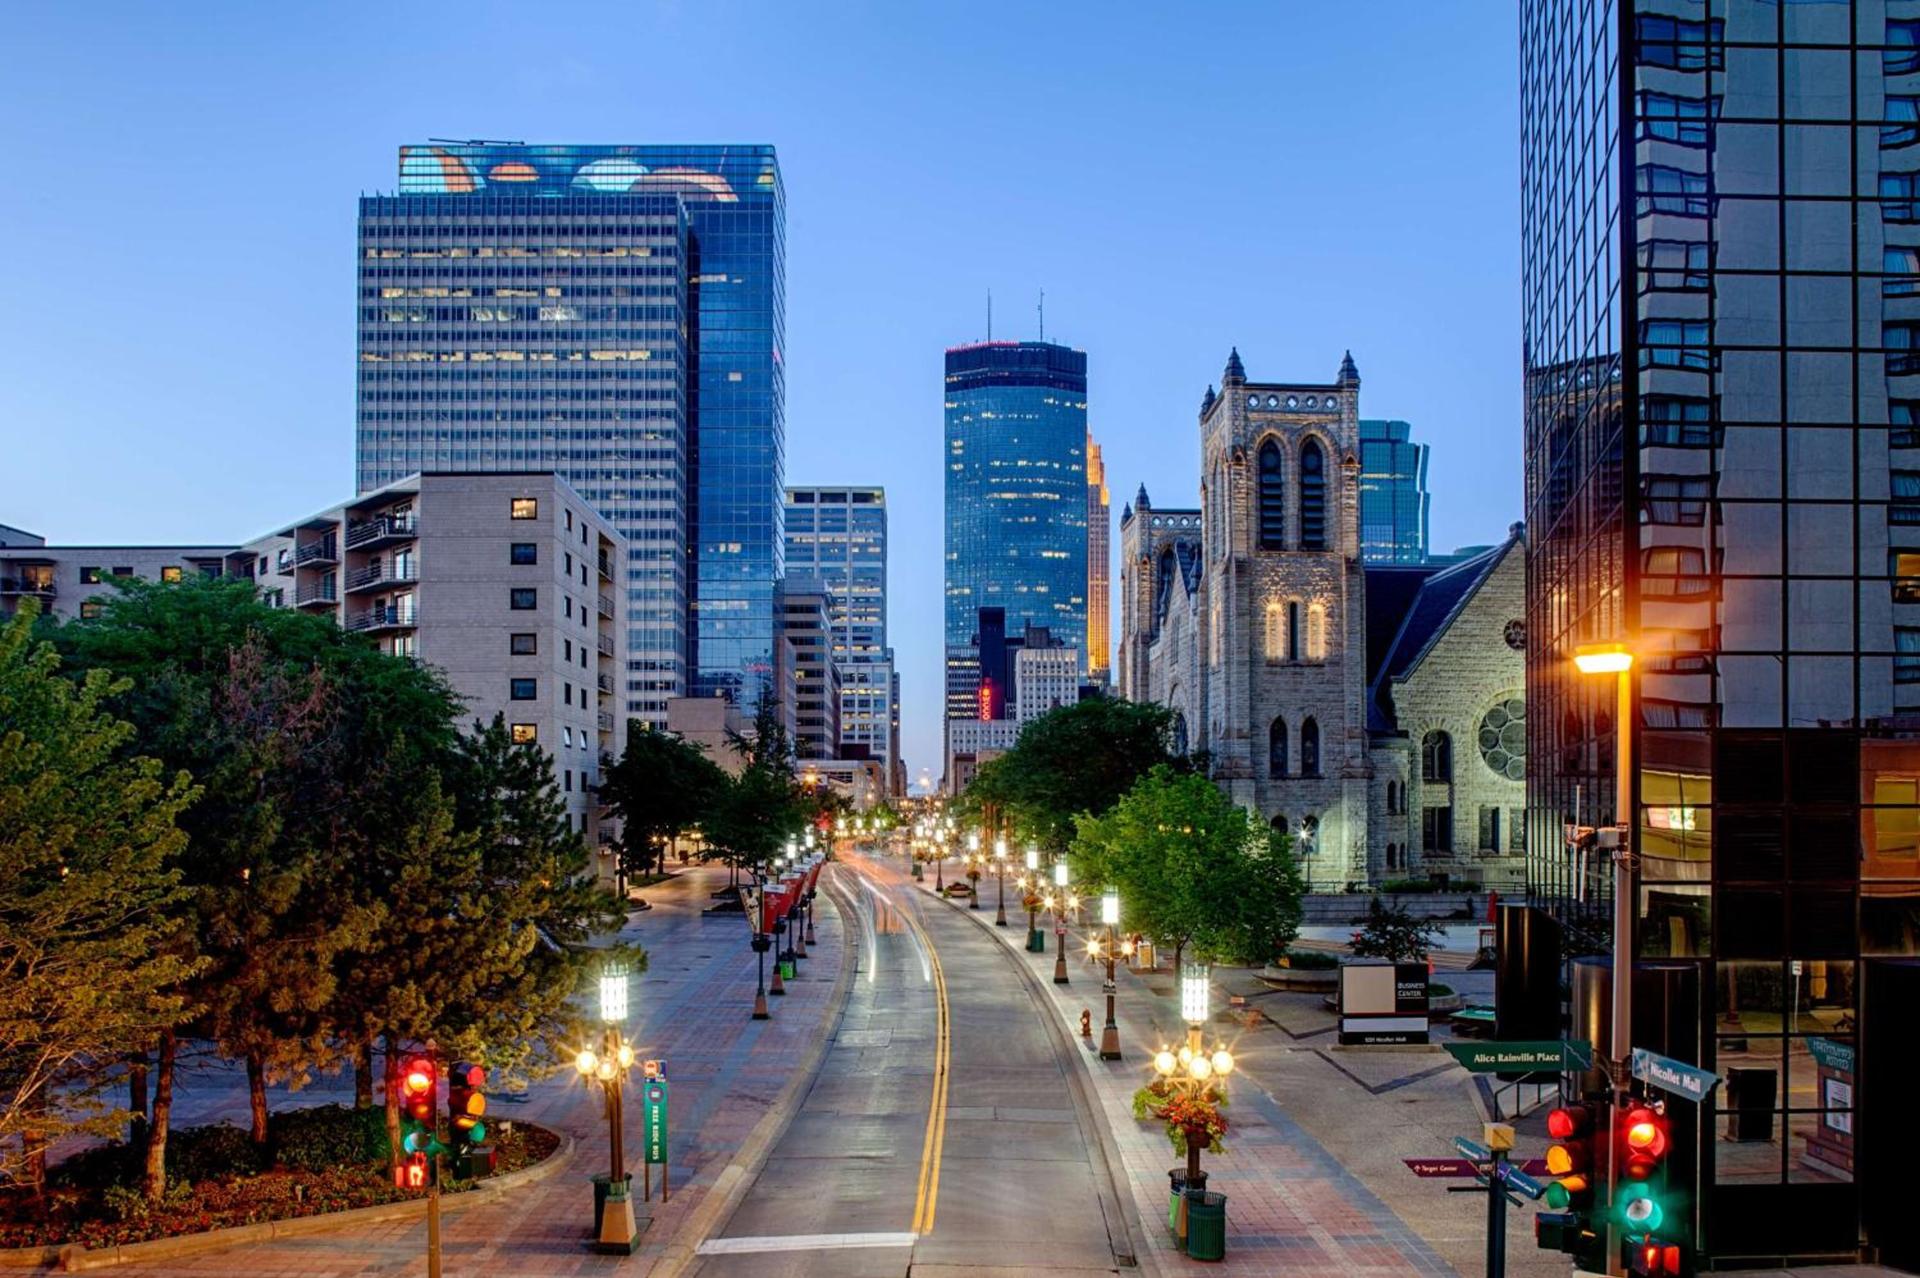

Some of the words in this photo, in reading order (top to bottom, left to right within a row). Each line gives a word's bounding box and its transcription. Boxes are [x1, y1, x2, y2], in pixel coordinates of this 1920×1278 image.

[1474, 1054, 1495, 1063] Alice
[1498, 1053, 1534, 1062] Rainville
[1537, 1052, 1560, 1061] Place
[1650, 1062, 1680, 1086] Nicollet
[1682, 1074, 1701, 1093] Mall
